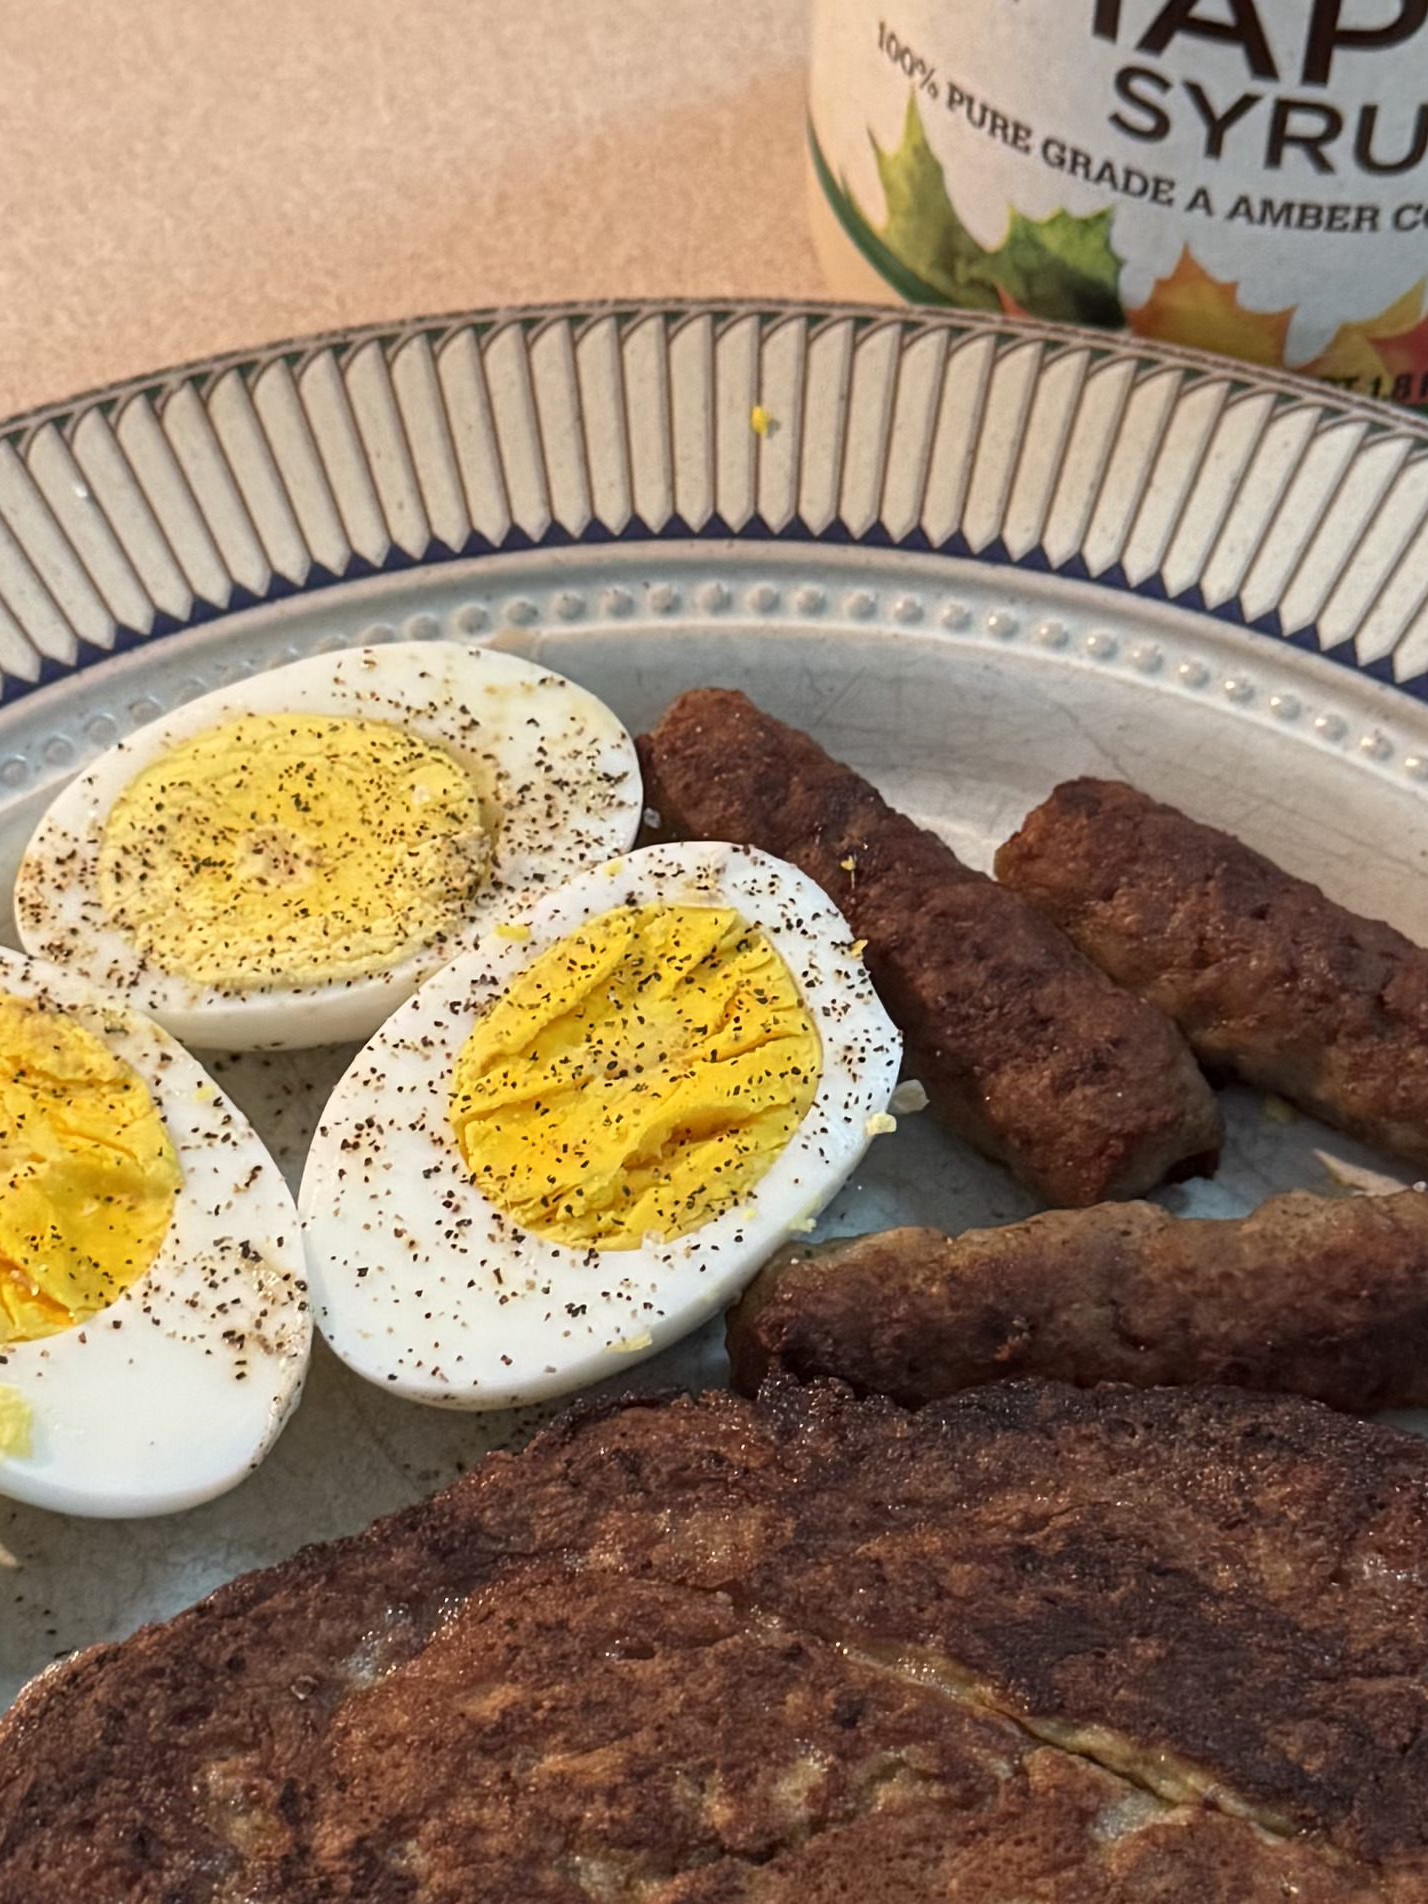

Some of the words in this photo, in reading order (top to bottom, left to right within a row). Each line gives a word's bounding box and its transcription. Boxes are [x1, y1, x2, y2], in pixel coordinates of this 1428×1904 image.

[876, 19, 940, 98] 100%
[945, 81, 1033, 156] PURE
[1041, 137, 1175, 206] GRADE
[1184, 187, 1215, 217] A
[1227, 193, 1382, 234] AMBER
